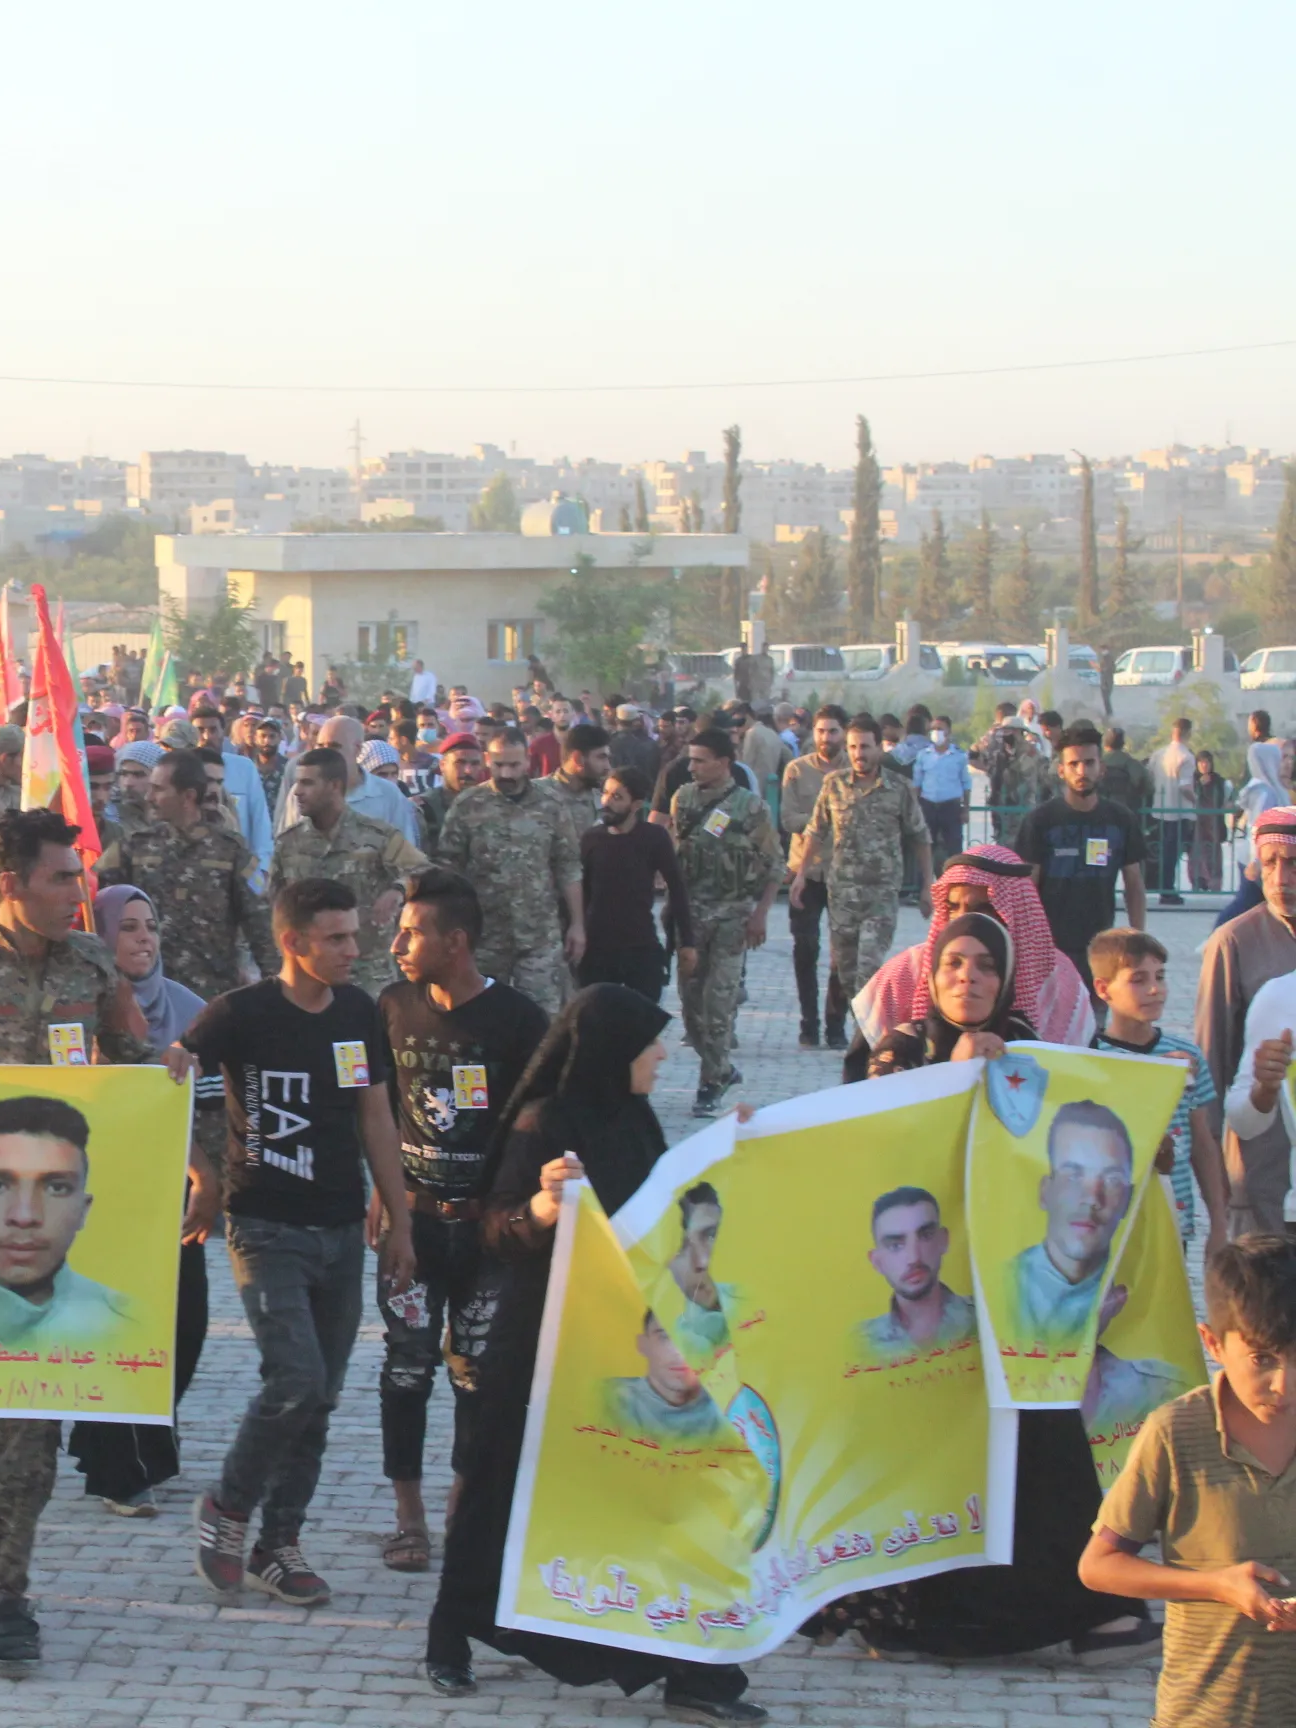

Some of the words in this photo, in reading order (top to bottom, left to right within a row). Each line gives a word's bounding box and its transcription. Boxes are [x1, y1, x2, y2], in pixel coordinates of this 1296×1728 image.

[261, 1069, 314, 1181] EA7
[47, 1345, 97, 1369] عبدالله
[107, 1347, 169, 1373] الشهيد:
[965, 1494, 983, 1531] لا
[645, 1585, 690, 1631] في
